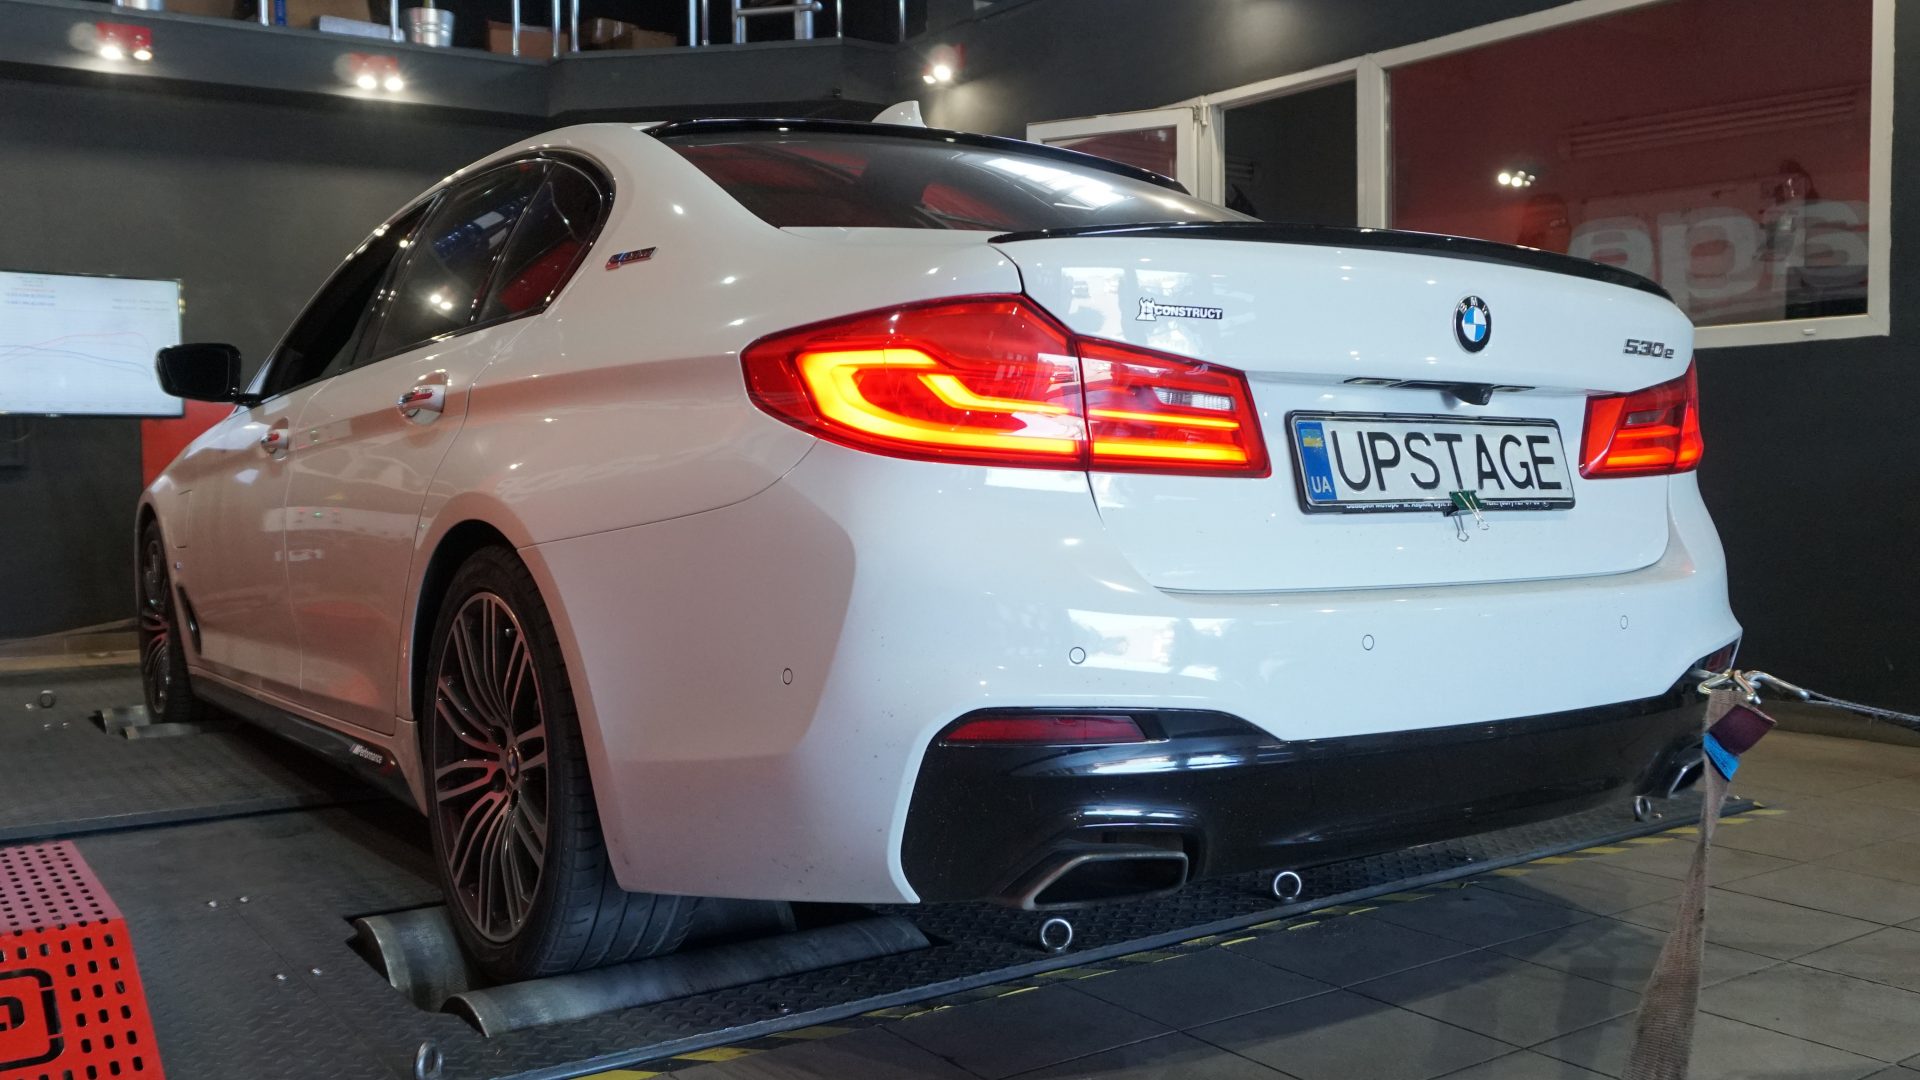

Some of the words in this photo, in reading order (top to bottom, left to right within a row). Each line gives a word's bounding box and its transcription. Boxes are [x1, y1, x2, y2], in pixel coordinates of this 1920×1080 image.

[1154, 304, 1223, 320] CONSTRUCT
[1623, 338, 1675, 359] 530e
[1330, 430, 1563, 492] UPSTAGE
[1311, 475, 1333, 494] UA
